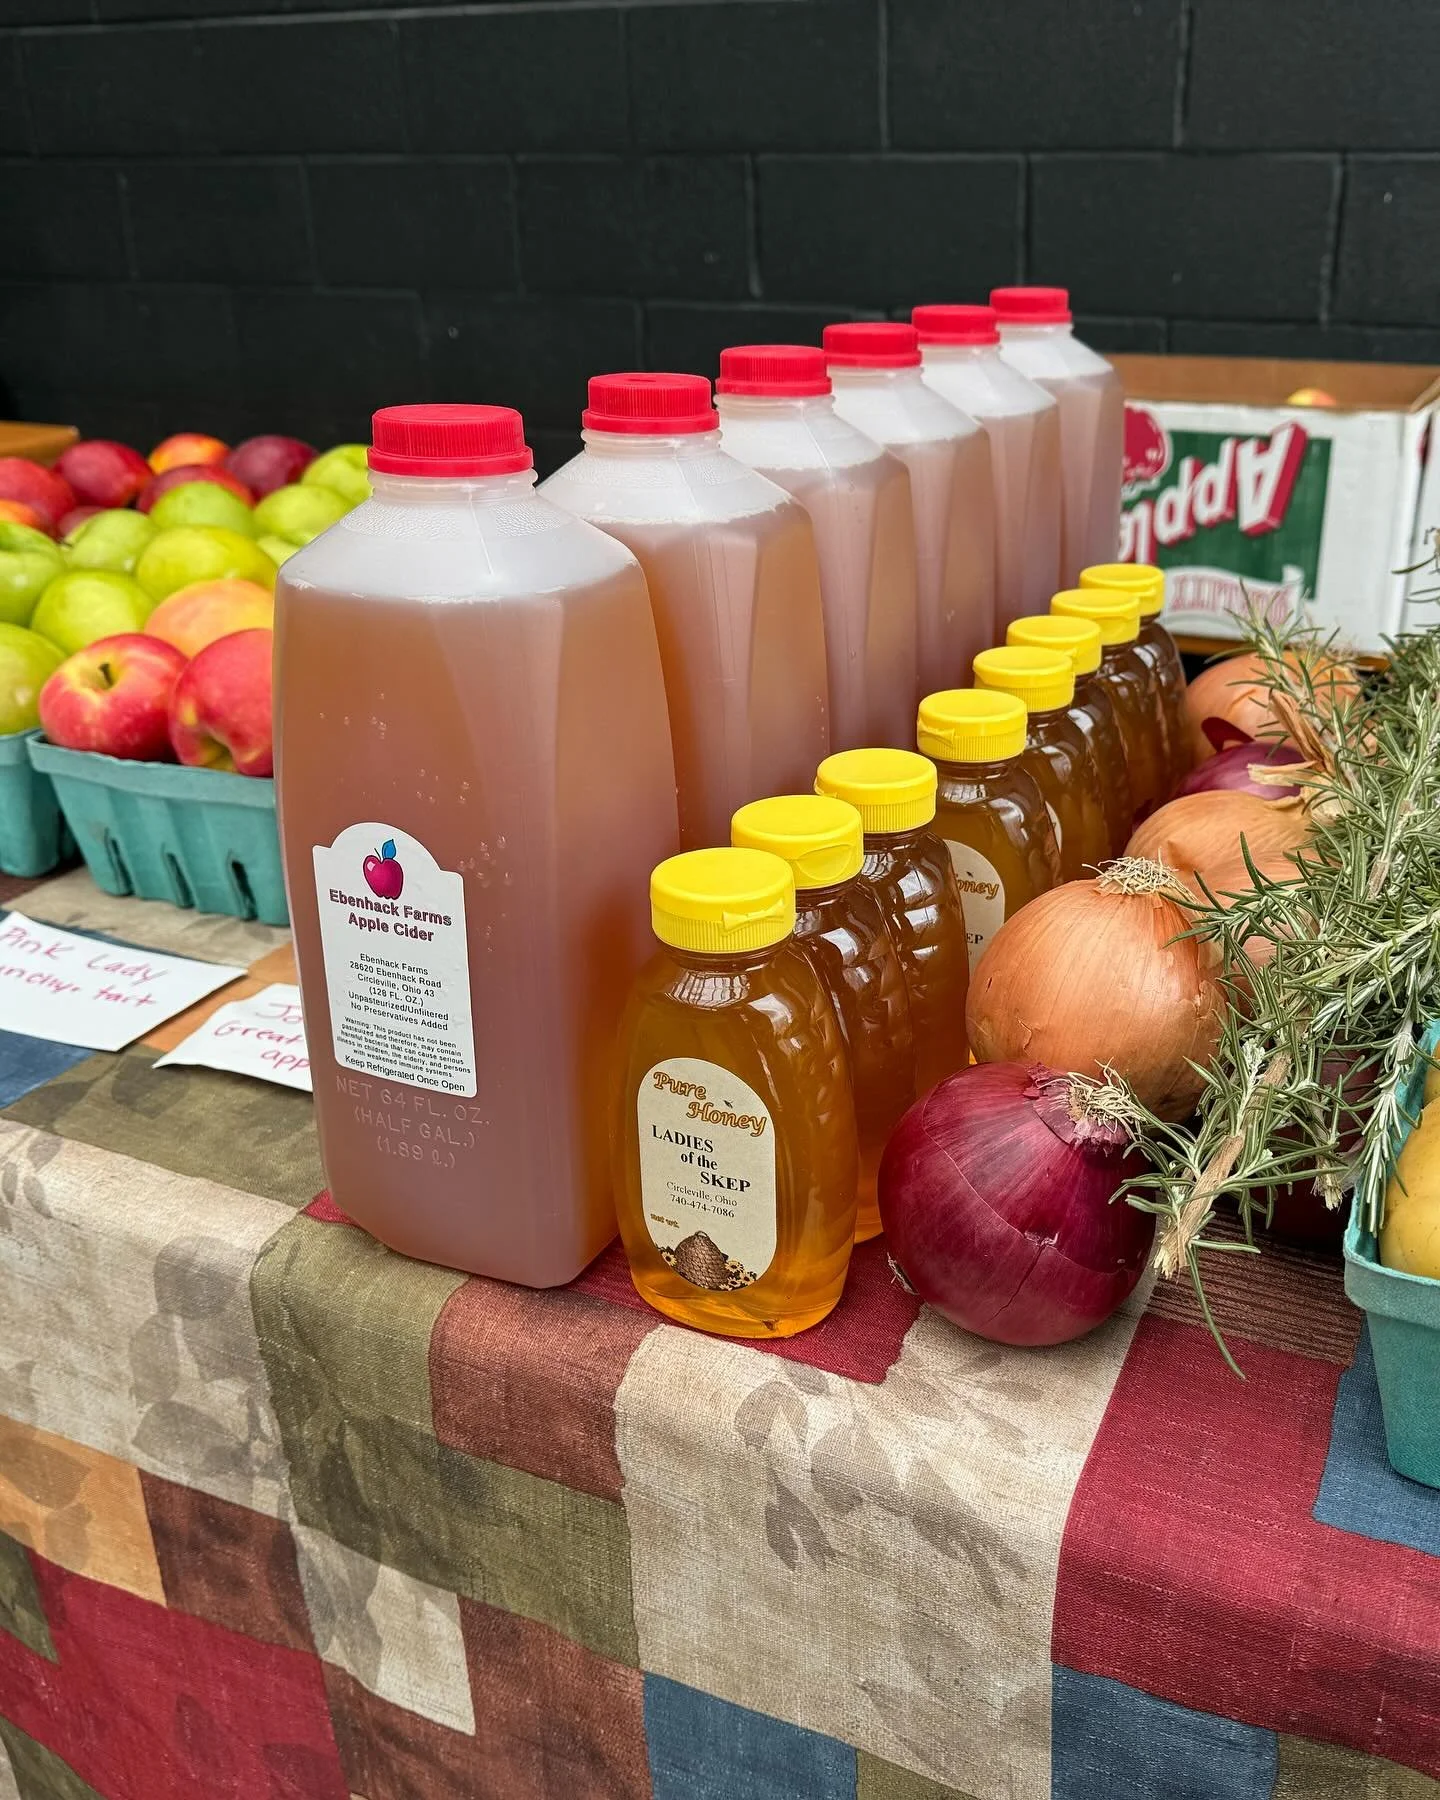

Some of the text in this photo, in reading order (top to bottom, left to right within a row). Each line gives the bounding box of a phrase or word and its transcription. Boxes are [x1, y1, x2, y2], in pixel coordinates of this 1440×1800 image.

[957, 879, 1000, 901] oney
[328, 888, 452, 926] Ebenhack Farms
[348, 912, 434, 942] Apple Cider
[966, 932, 984, 945] EP
[86, 953, 169, 987] Lady
[349, 960, 442, 989] 28620 Ebenhack Road
[359, 953, 429, 976] Ebenhack Farms
[357, 973, 435, 998] Circleville, Ohio 43
[348, 990, 449, 1021] Unpasteurized/Unfiltered
[389, 991, 403, 1001] FL.
[405, 994, 424, 1008] OZ.)
[350, 1001, 448, 1031] No Preservatives Added
[213, 1020, 305, 1045] Great
[373, 1024, 386, 1033] This
[387, 1029, 412, 1039] product
[413, 1034, 425, 1043] has
[439, 1040, 457, 1049] been
[375, 1033, 387, 1041] and
[421, 1044, 435, 1053] may
[436, 1047, 462, 1057] contain
[260, 1050, 310, 1071] app
[353, 1048, 366, 1057] with
[367, 1053, 398, 1065] weakened
[399, 1060, 424, 1072] immune
[364, 1037, 389, 1049] bacteria
[390, 1043, 403, 1052] that
[404, 1047, 417, 1055] can
[418, 1051, 438, 1060] cause
[439, 1056, 464, 1065] serious
[391, 1051, 402, 1059] the
[443, 1063, 471, 1074] persons
[344, 1055, 465, 1092] Keep Refrigerated Once Open
[652, 1070, 707, 1101] Pure
[336, 1075, 492, 1127] NET 64 FL. OZ.
[353, 1105, 476, 1150] (HALF GAL.)
[685, 1101, 768, 1138] Honey
[377, 1135, 424, 1161] (1.89
[652, 1125, 714, 1153] LADIES
[680, 1151, 719, 1171] of the
[666, 1181, 738, 1207] Circleville, Ohio
[700, 1171, 751, 1193] SKEP
[670, 1194, 735, 1218] 740-474-7086
